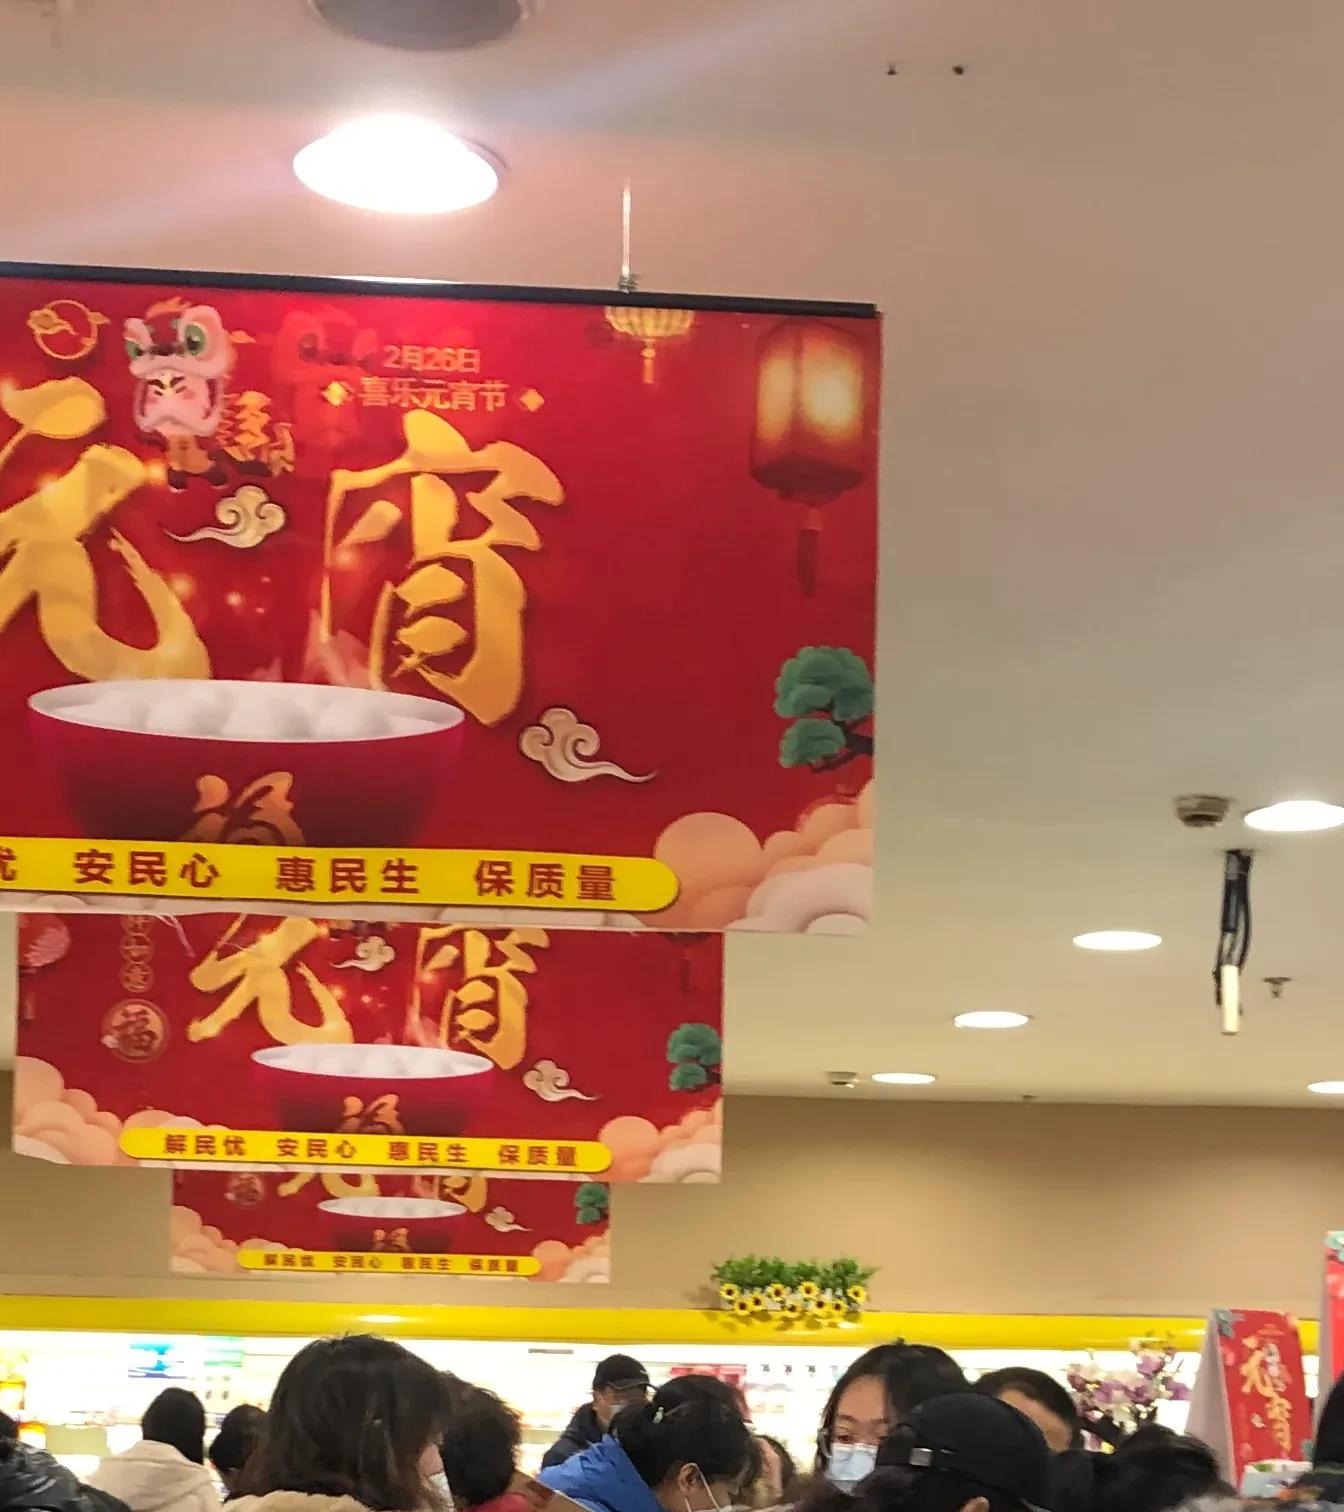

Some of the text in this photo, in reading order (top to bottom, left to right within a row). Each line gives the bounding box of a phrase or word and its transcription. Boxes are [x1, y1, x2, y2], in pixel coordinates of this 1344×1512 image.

[383, 344, 482, 373] 2月26日
[358, 376, 512, 412] 喜乐元宵节
[73, 849, 221, 891] 安民心
[275, 856, 420, 896] 惠民生
[473, 859, 617, 901] 保质量
[163, 1134, 579, 1167] 解民忧 安民心 惠民生 保质量
